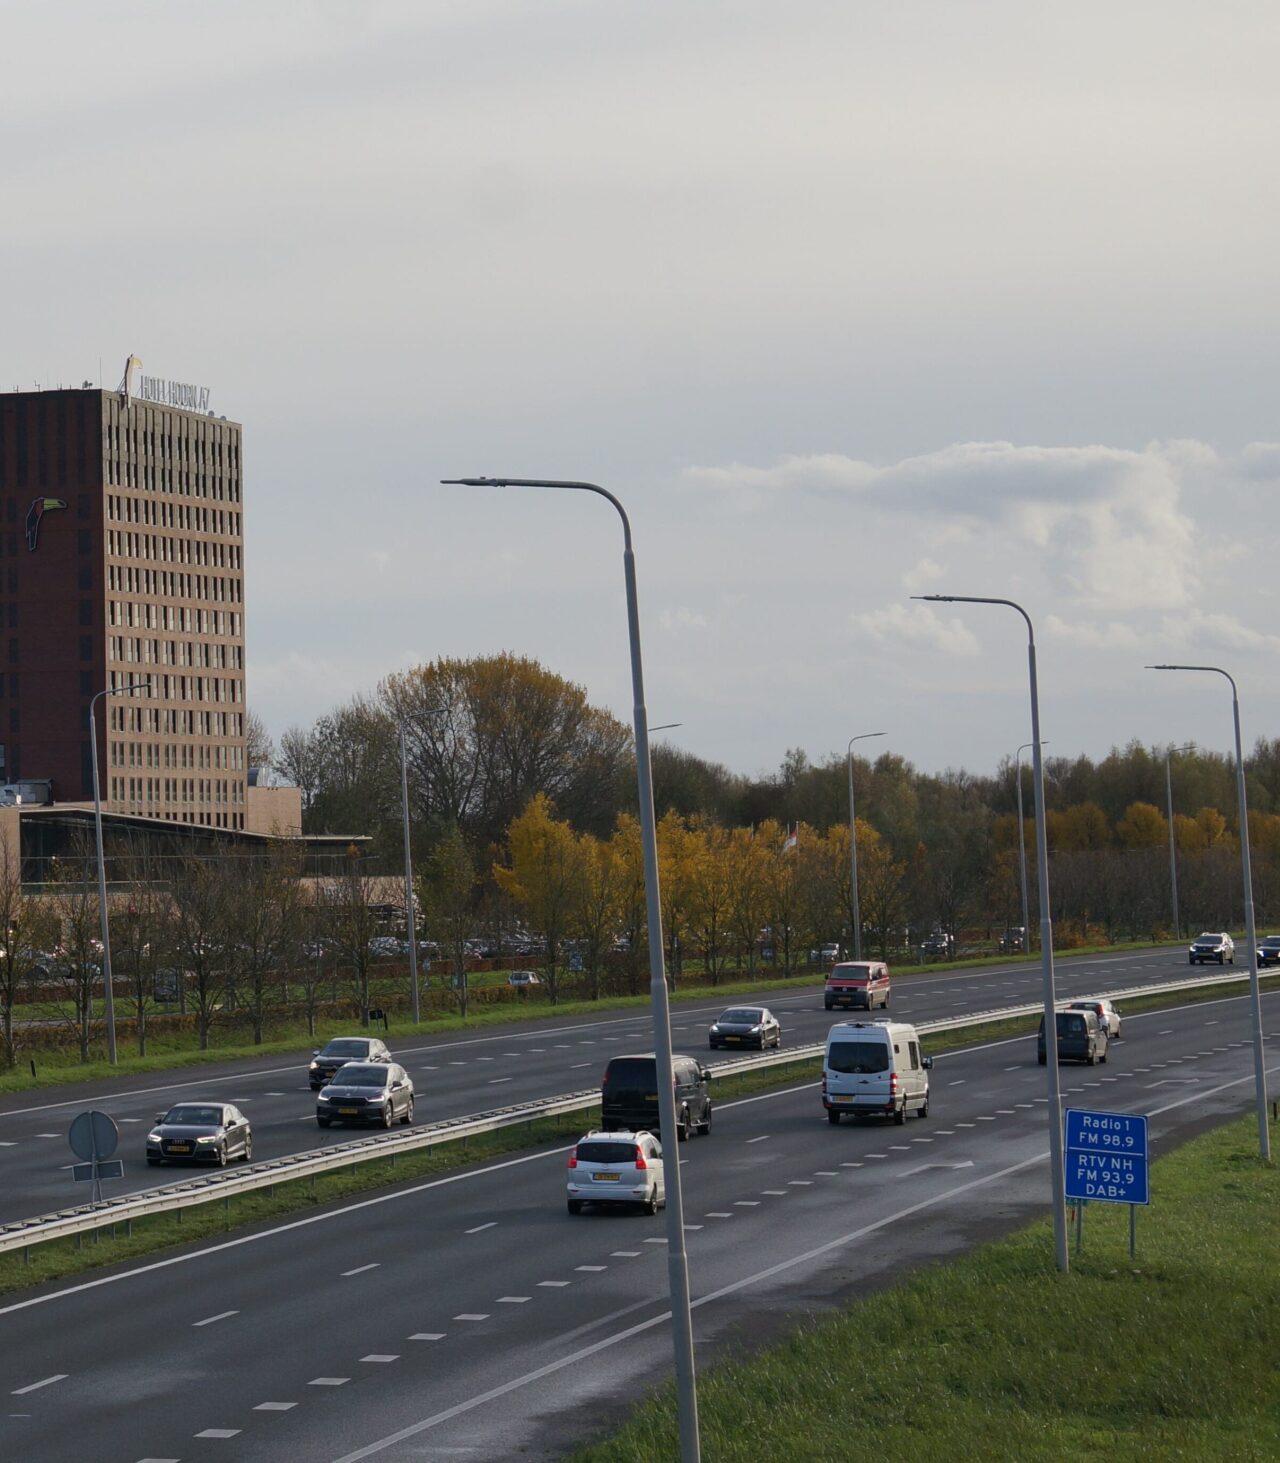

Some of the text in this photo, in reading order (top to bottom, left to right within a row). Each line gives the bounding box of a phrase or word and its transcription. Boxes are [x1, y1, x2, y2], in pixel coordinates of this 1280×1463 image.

[1083, 1116, 1130, 1131] Radio 1
[1079, 1131, 1134, 1148] FM 98.9
[1078, 1154, 1133, 1171] RTV NH
[1077, 1168, 1135, 1185] FM 93.9
[1086, 1183, 1126, 1197] DAB+
